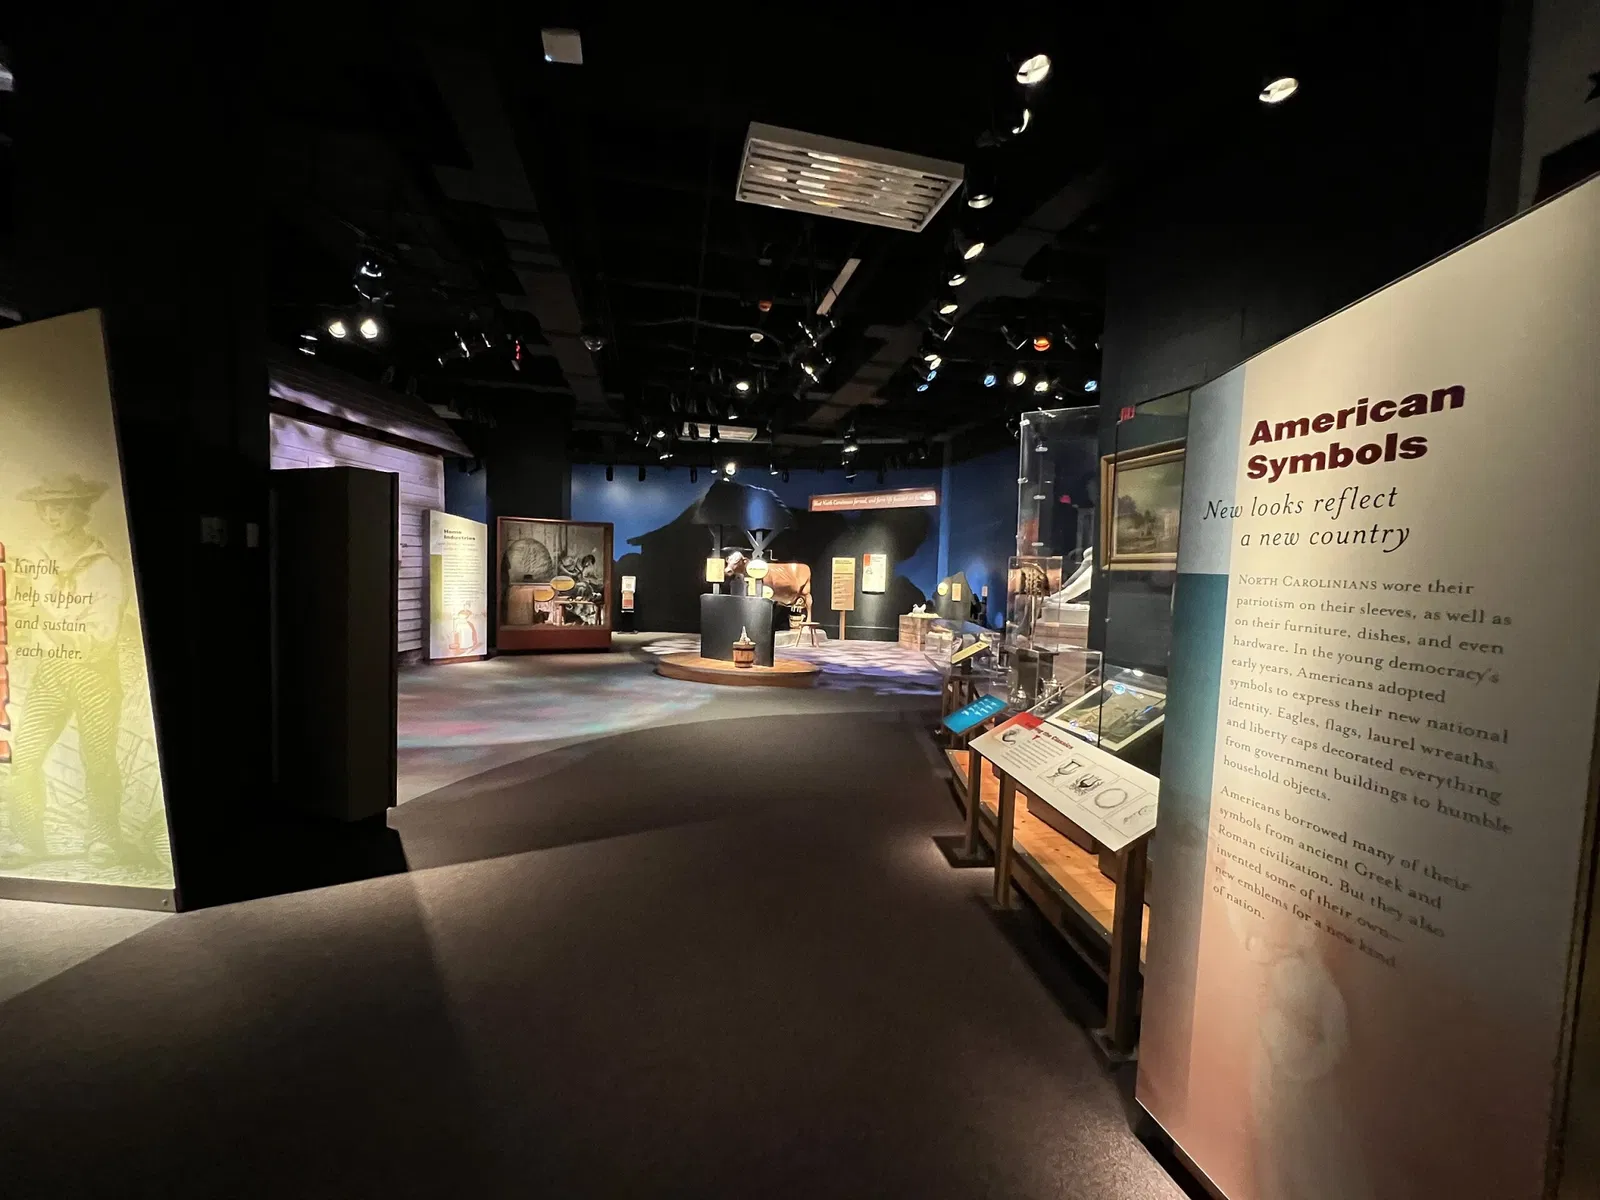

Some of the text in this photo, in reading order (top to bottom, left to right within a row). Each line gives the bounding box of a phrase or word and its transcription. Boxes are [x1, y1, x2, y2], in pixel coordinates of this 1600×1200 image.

[1249, 384, 1466, 446] American
[1246, 433, 1428, 483] Symbols
[1203, 486, 1398, 521] New looks reflect
[1240, 524, 1410, 553] a new country
[14, 558, 60, 580] Kinfolk
[1238, 574, 1475, 594] NORTH CAROLINIANS wore their
[14, 586, 93, 610] help support
[1236, 597, 1512, 626] patriotism on their sleeves, as well as
[15, 615, 87, 633] and sustain
[1234, 617, 1504, 655] on their furniture, dishes, and even
[15, 644, 82, 660] each other.
[1233, 635, 1289, 653] hardware.
[1294, 643, 1308, 656] In
[1312, 645, 1333, 659] the
[1337, 652, 1384, 671] young
[1231, 657, 1446, 703] early years, Americans adopted
[1228, 696, 1273, 717] identity.
[1277, 707, 1320, 728] Eagles,
[1325, 719, 1362, 739] flags,
[1368, 728, 1415, 751] laurel
[1229, 677, 1509, 744] symbols to express their new national
[1223, 754, 1332, 801] household objects.
[1225, 735, 1513, 835] from government buildings to humble
[1226, 718, 1503, 806] and liberty caps decorated everything
[1219, 807, 1442, 909] symbols from ancient Greek and
[1220, 785, 1472, 892] Americans borrowed many of their
[1213, 885, 1266, 920] of nation.
[1216, 844, 1262, 875] invented
[1265, 869, 1297, 892] some
[1300, 888, 1315, 901] of
[1317, 895, 1352, 920] their
[1218, 823, 1446, 938] Roman civilization. But they also
[1215, 865, 1397, 969] new emblems for a new kind
